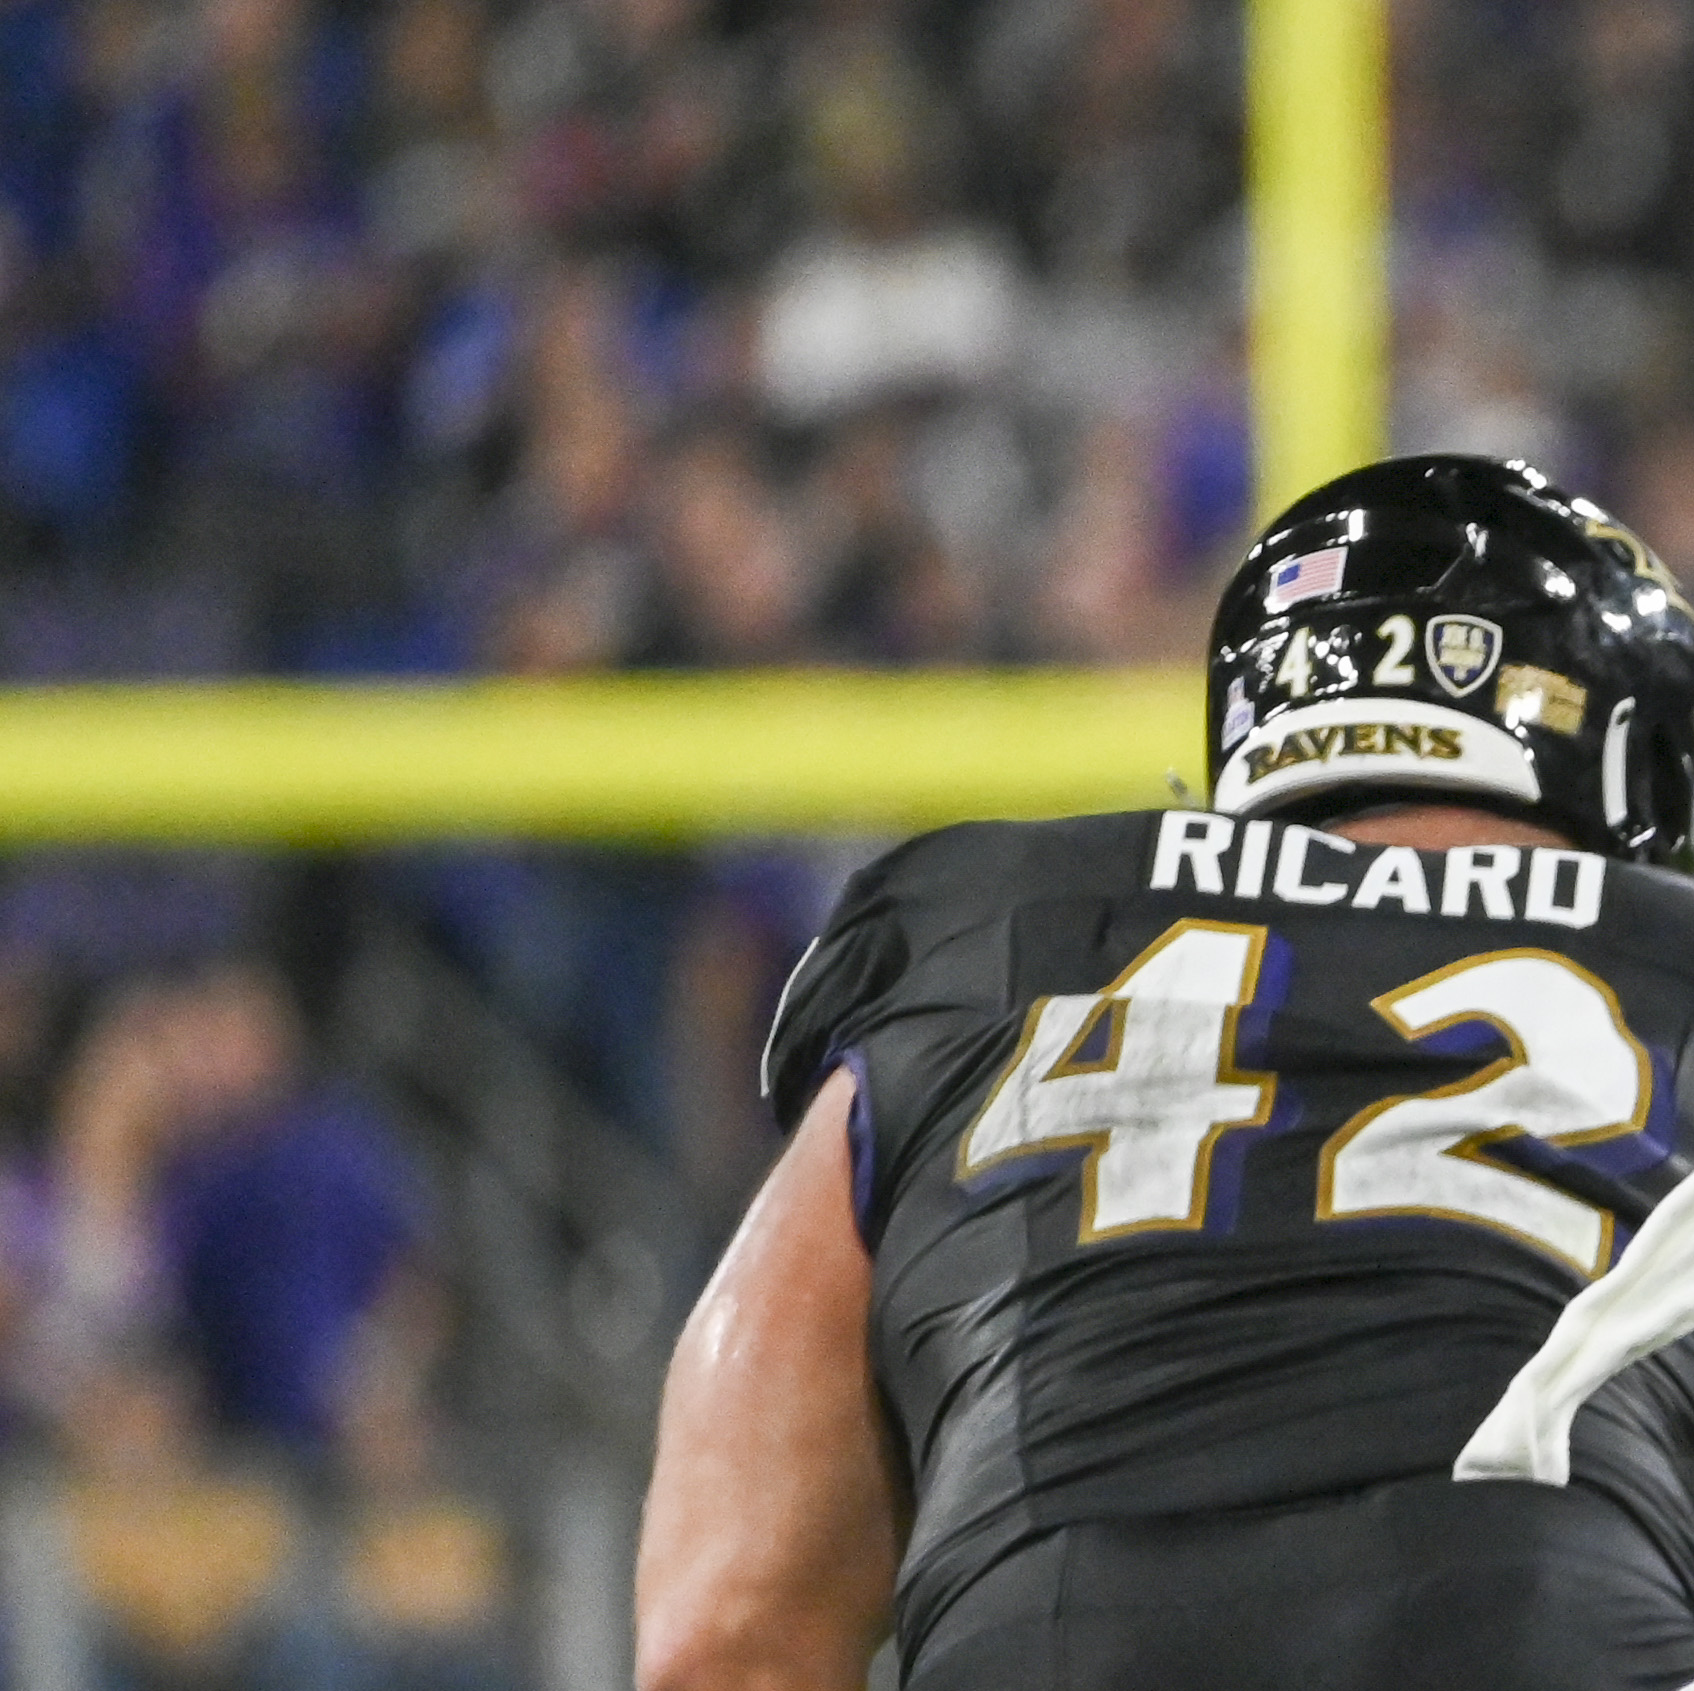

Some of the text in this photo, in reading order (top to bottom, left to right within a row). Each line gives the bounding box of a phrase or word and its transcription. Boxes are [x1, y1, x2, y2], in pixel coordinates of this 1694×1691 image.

[1243, 722, 1462, 782] RAVENS
[1150, 810, 1606, 928] RICARD
[954, 916, 1656, 1279] 42
